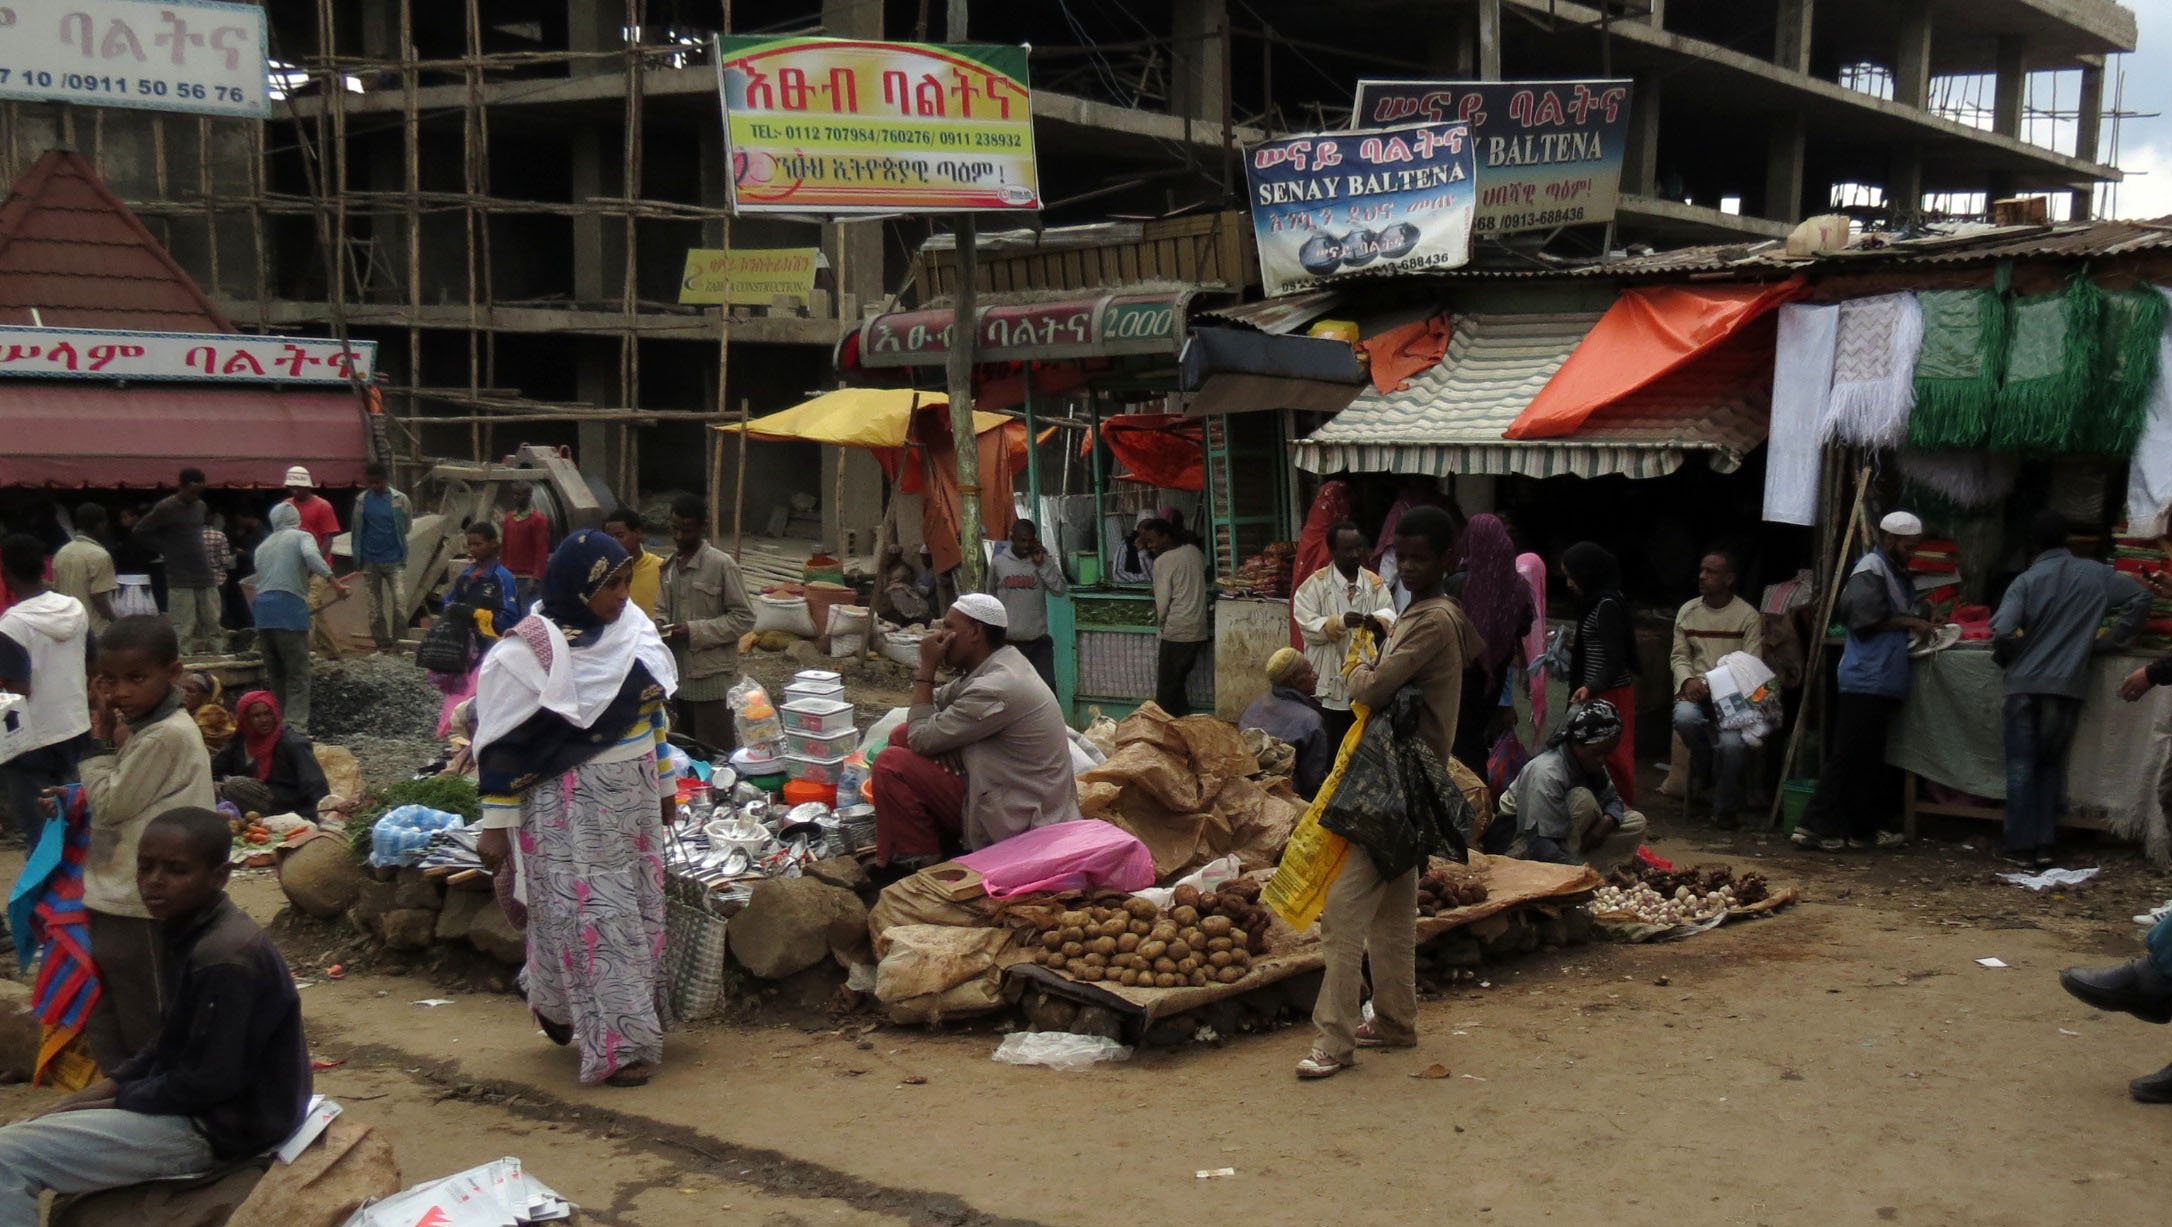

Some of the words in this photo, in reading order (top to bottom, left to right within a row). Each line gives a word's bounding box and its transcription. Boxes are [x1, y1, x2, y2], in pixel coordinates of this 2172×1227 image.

[59, 10, 249, 71] ባልትና
[22, 70, 52, 88] 10
[138, 79, 168, 97] 50
[176, 82, 207, 100] 56
[214, 85, 244, 103] 76
[882, 66, 1010, 120] ባልትና
[1509, 85, 1627, 129] ባልትና
[785, 124, 821, 141] 0112
[939, 132, 971, 146] 0911
[975, 133, 1022, 148] 238932
[1358, 126, 1469, 165] ባልትና
[1487, 131, 1603, 167] BALTENA
[1258, 175, 1341, 207] SENAY
[1348, 161, 1468, 197] BALTENA
[986, 312, 1091, 346] ባልትና
[1104, 308, 1174, 338] 2000
[184, 345, 362, 379] ባልትና
